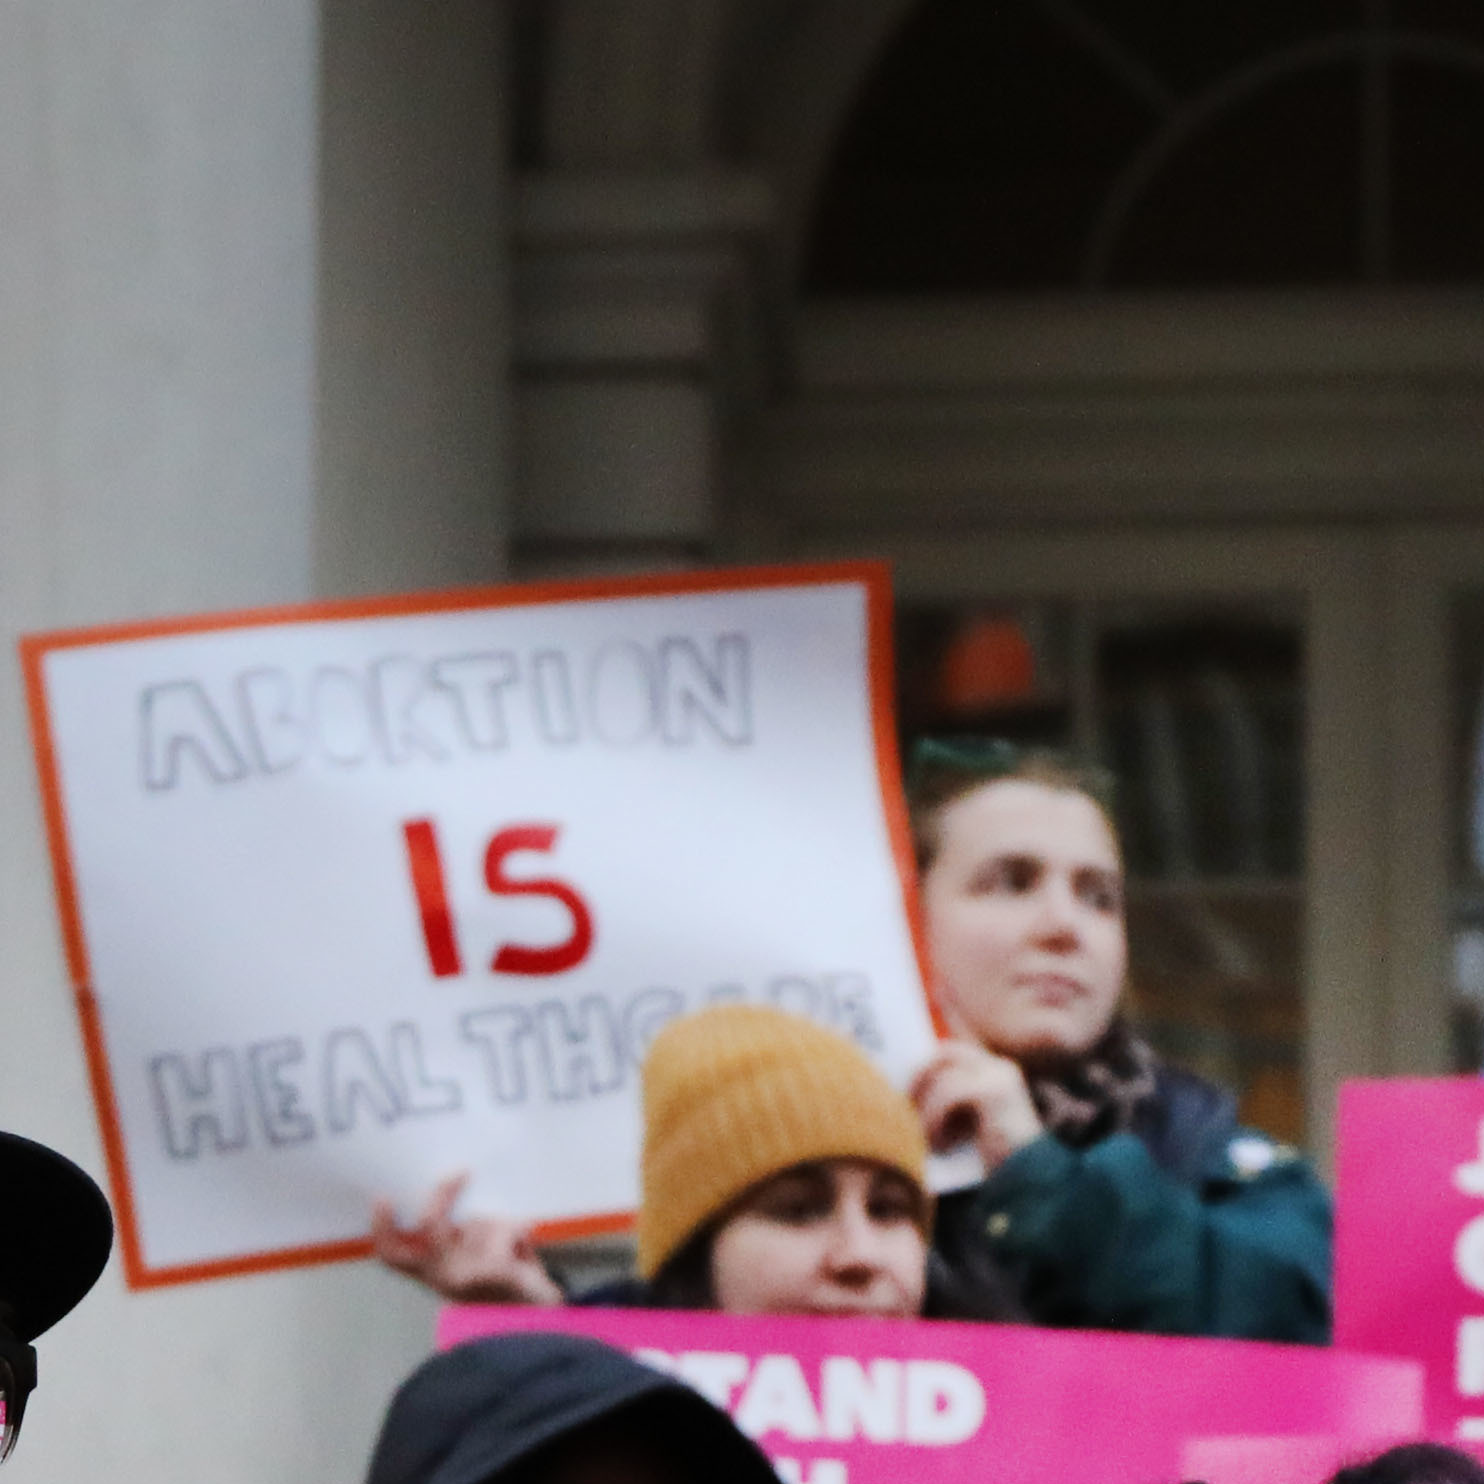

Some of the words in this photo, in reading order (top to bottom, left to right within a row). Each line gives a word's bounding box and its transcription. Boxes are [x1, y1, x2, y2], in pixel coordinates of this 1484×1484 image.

[139, 633, 754, 790] ABORTION
[402, 817, 596, 979] IS
[634, 1348, 986, 1446] TAND
